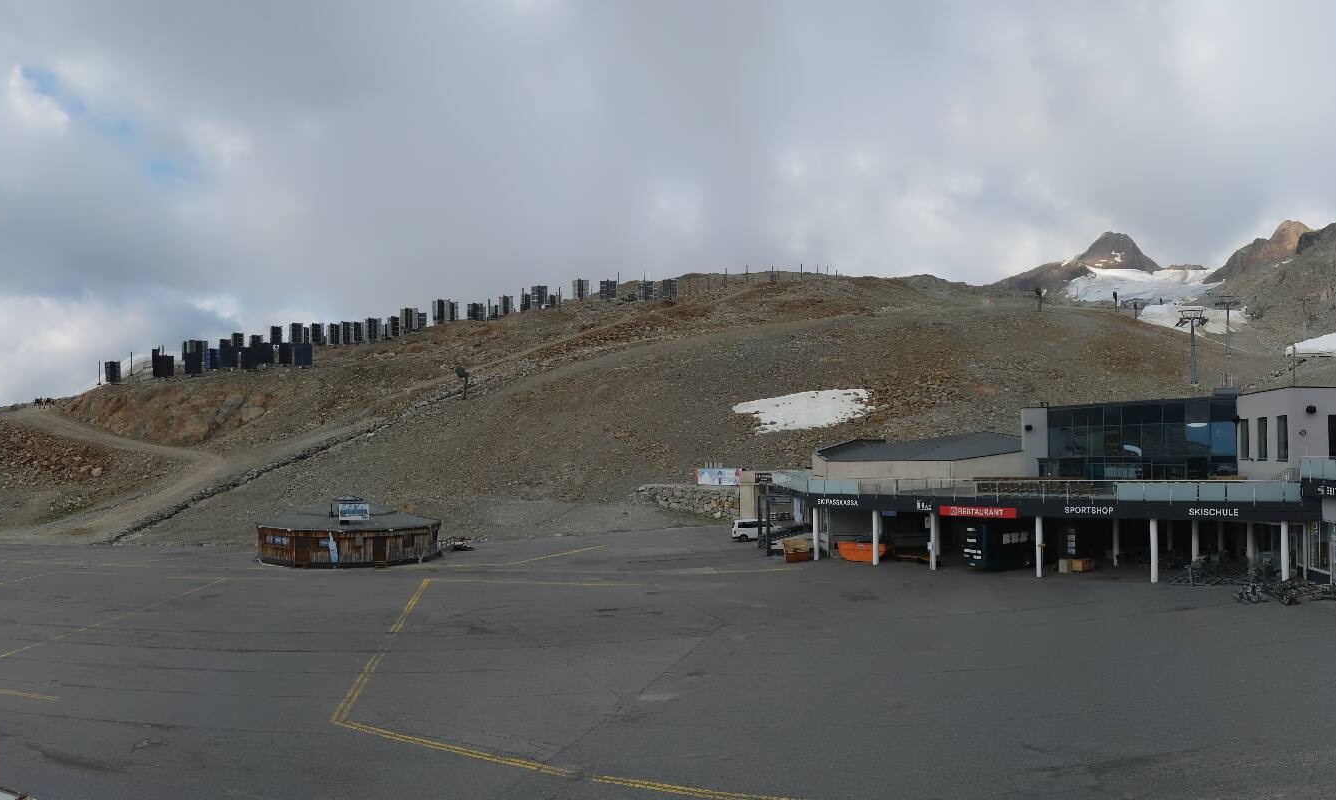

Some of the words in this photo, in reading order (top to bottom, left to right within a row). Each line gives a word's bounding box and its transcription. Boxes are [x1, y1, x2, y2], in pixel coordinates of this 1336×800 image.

[957, 507, 1004, 517] RESTAURANT
[1064, 506, 1114, 515] SPORTSHOP
[1188, 507, 1239, 517] SKISCHULE
